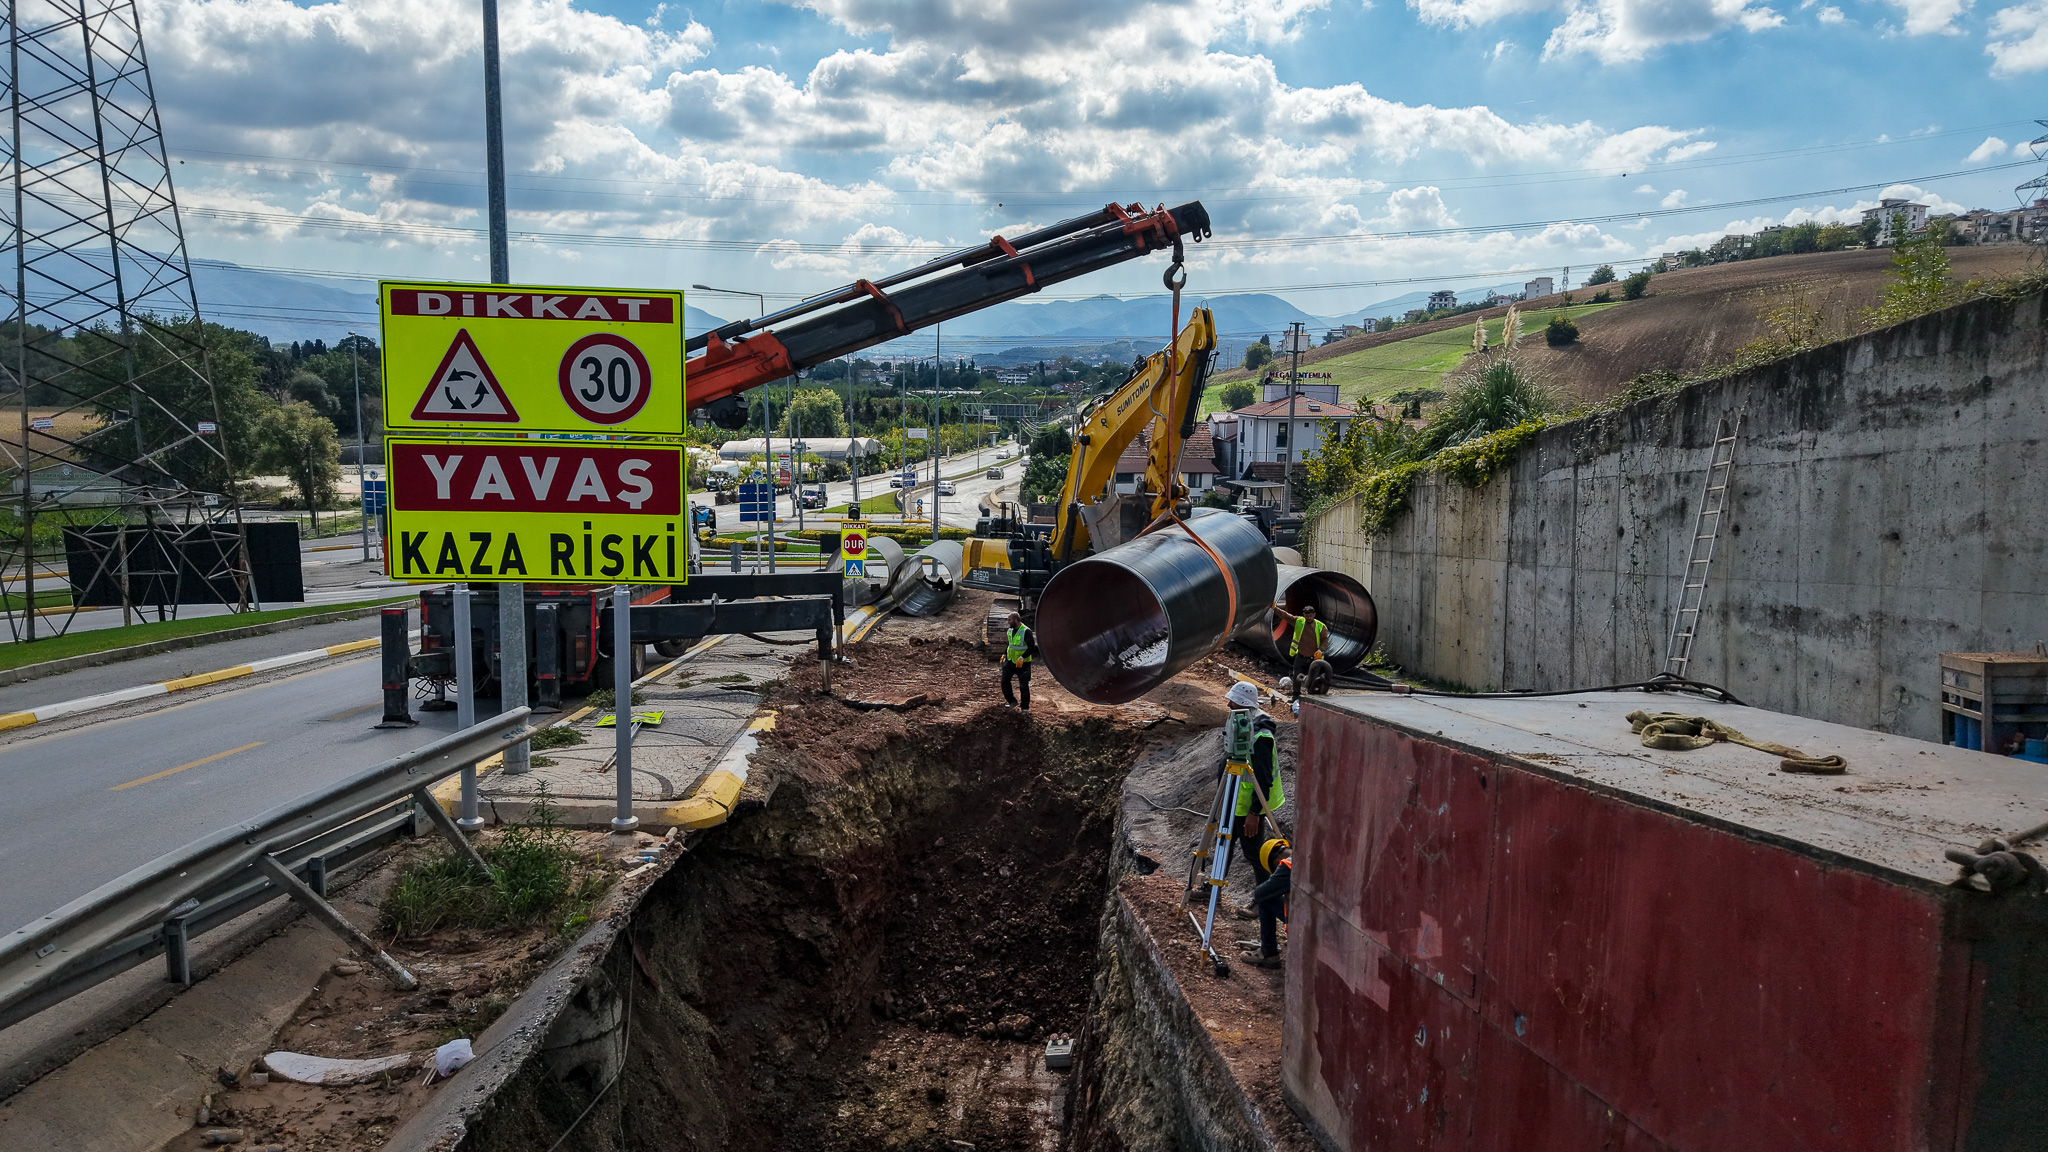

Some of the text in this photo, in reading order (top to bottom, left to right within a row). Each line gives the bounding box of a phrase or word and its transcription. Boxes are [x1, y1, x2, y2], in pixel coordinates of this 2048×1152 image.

[417, 292, 650, 321] DİKKAT
[580, 356, 632, 403] 30
[1116, 378, 1150, 417] SUMITOMO
[421, 454, 654, 510] YAVAŞ
[401, 520, 677, 578] KAZA RİSKİ
[844, 539, 864, 549] DUR
